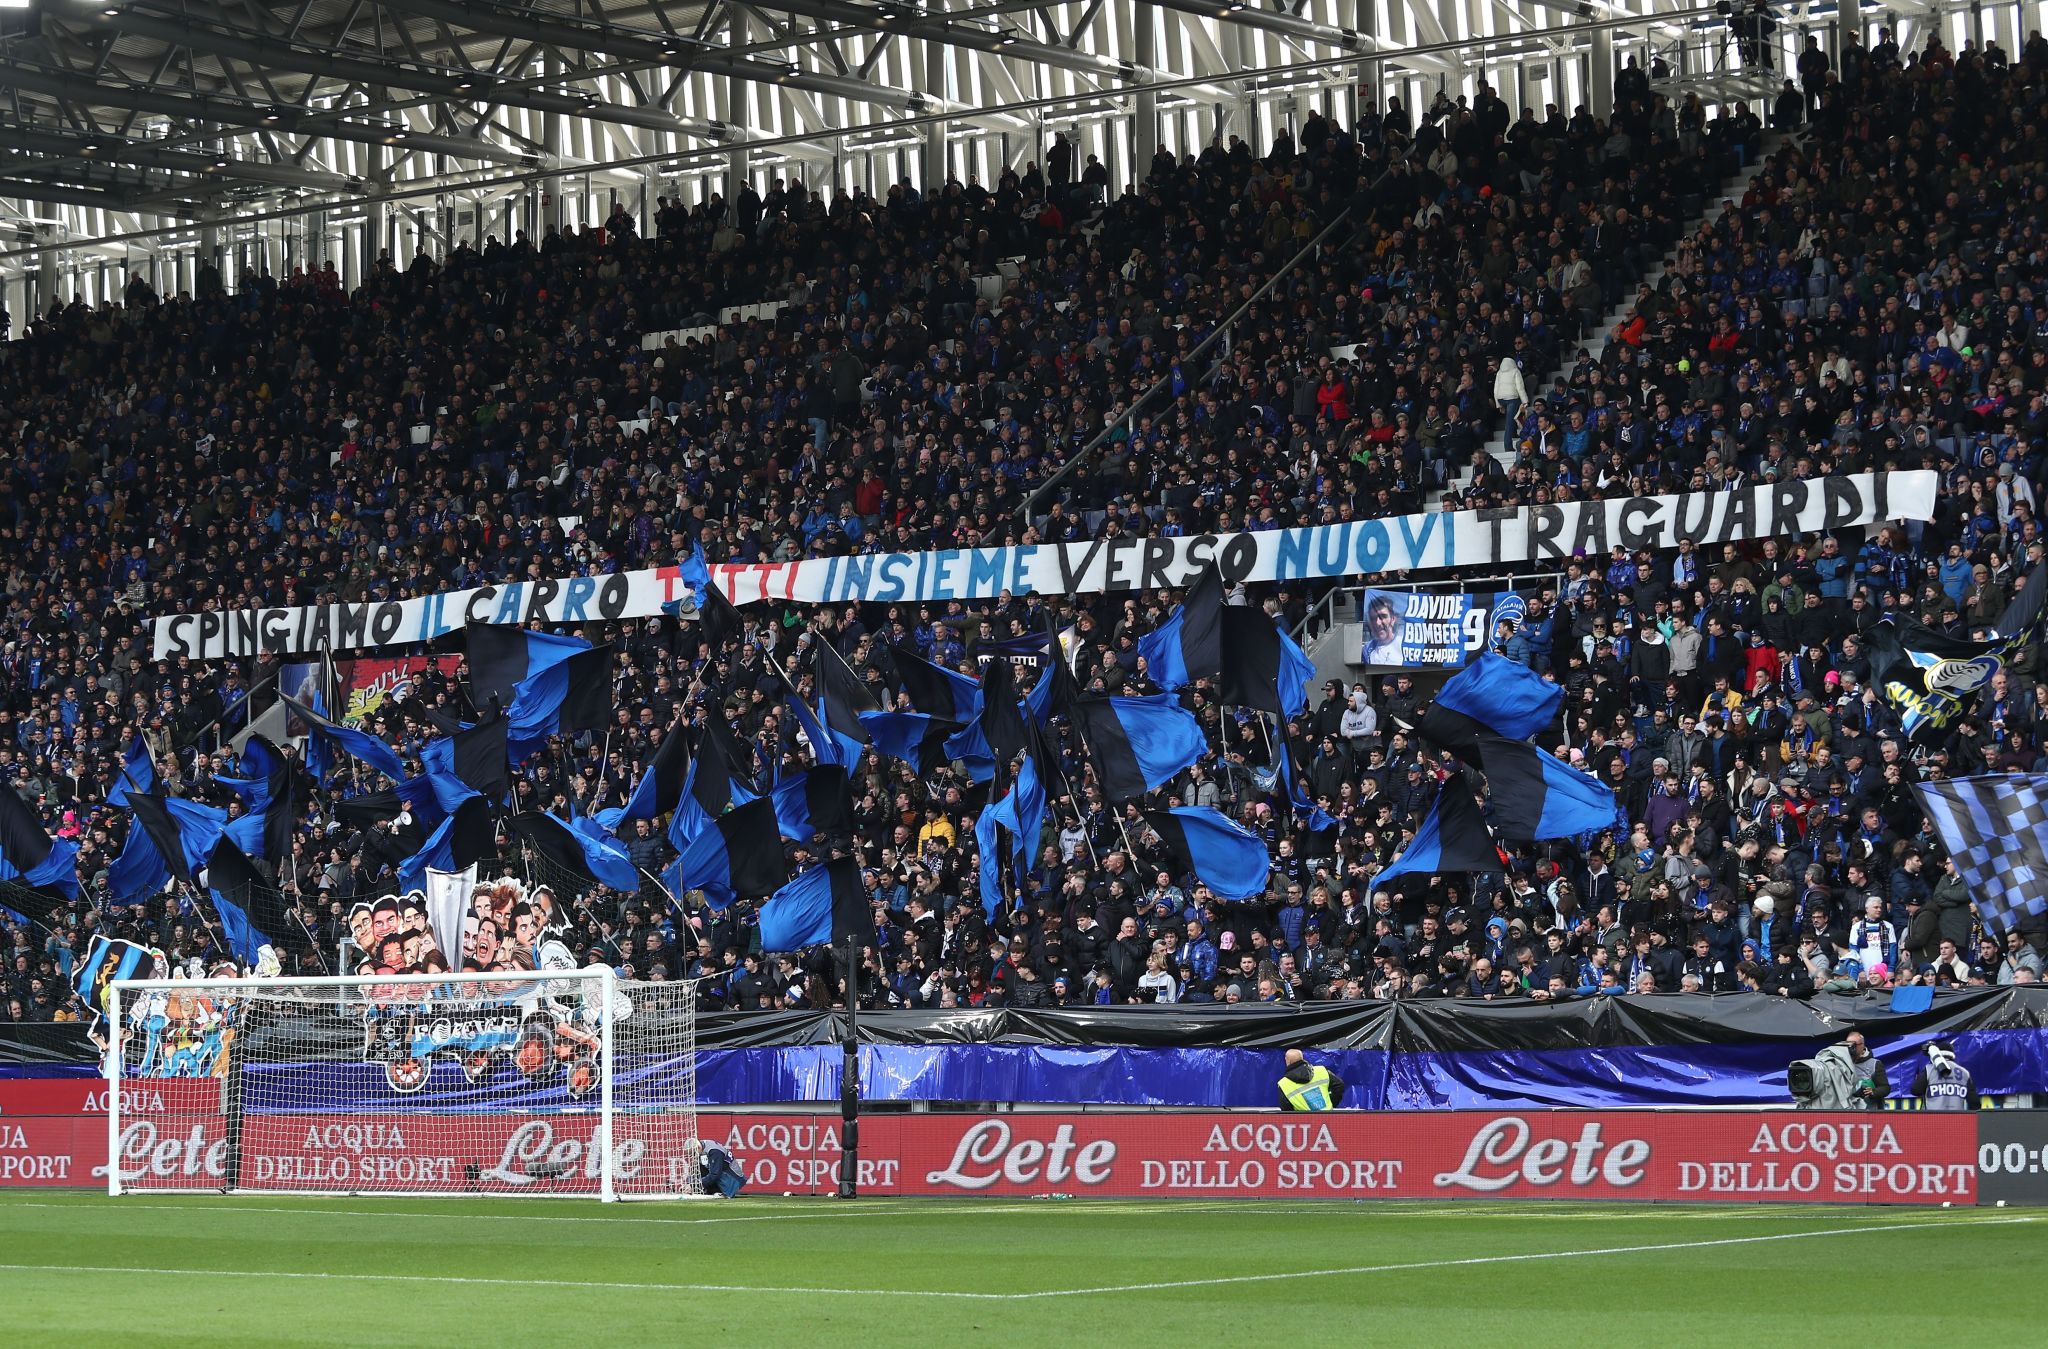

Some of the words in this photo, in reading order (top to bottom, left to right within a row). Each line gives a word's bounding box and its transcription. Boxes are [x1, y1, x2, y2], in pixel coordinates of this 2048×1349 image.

[165, 601, 402, 662] SPINGIAMO
[420, 594, 451, 638] IL
[468, 573, 629, 624] CARRO
[656, 560, 800, 607] TTTI
[822, 545, 1038, 604] INSIEME
[1056, 532, 1258, 594] VERSO
[1276, 511, 1456, 579] NUOVI
[1476, 471, 1889, 564] TRAGUARDI
[1405, 595, 1464, 618] DAVIDE
[1403, 623, 1460, 644] BOMBER
[1463, 608, 1487, 651] 9
[1402, 647, 1419, 662] PER
[1421, 648, 1459, 663] SEMPRE
[356, 664, 409, 707] YOU'LL
[1930, 1084, 1967, 1098] PHOTO
[304, 1125, 406, 1154] ACQUA
[479, 1120, 645, 1184] Lete
[724, 1124, 843, 1157] ACQUA
[926, 1119, 1117, 1189] Lete
[1203, 1123, 1338, 1158] ACQUA
[1434, 1117, 1650, 1190] Lete
[1749, 1123, 1903, 1158] ACQUA
[0, 1155, 71, 1179] PORT
[256, 1157, 348, 1181] DELLO
[359, 1157, 455, 1182] SPORT
[1978, 1142, 2048, 1173] 00:
[1141, 1160, 1265, 1189] DELLO
[1277, 1160, 1403, 1190] SPORT
[1678, 1161, 1821, 1193] DELLO
[1833, 1162, 1976, 1195] SPORT
